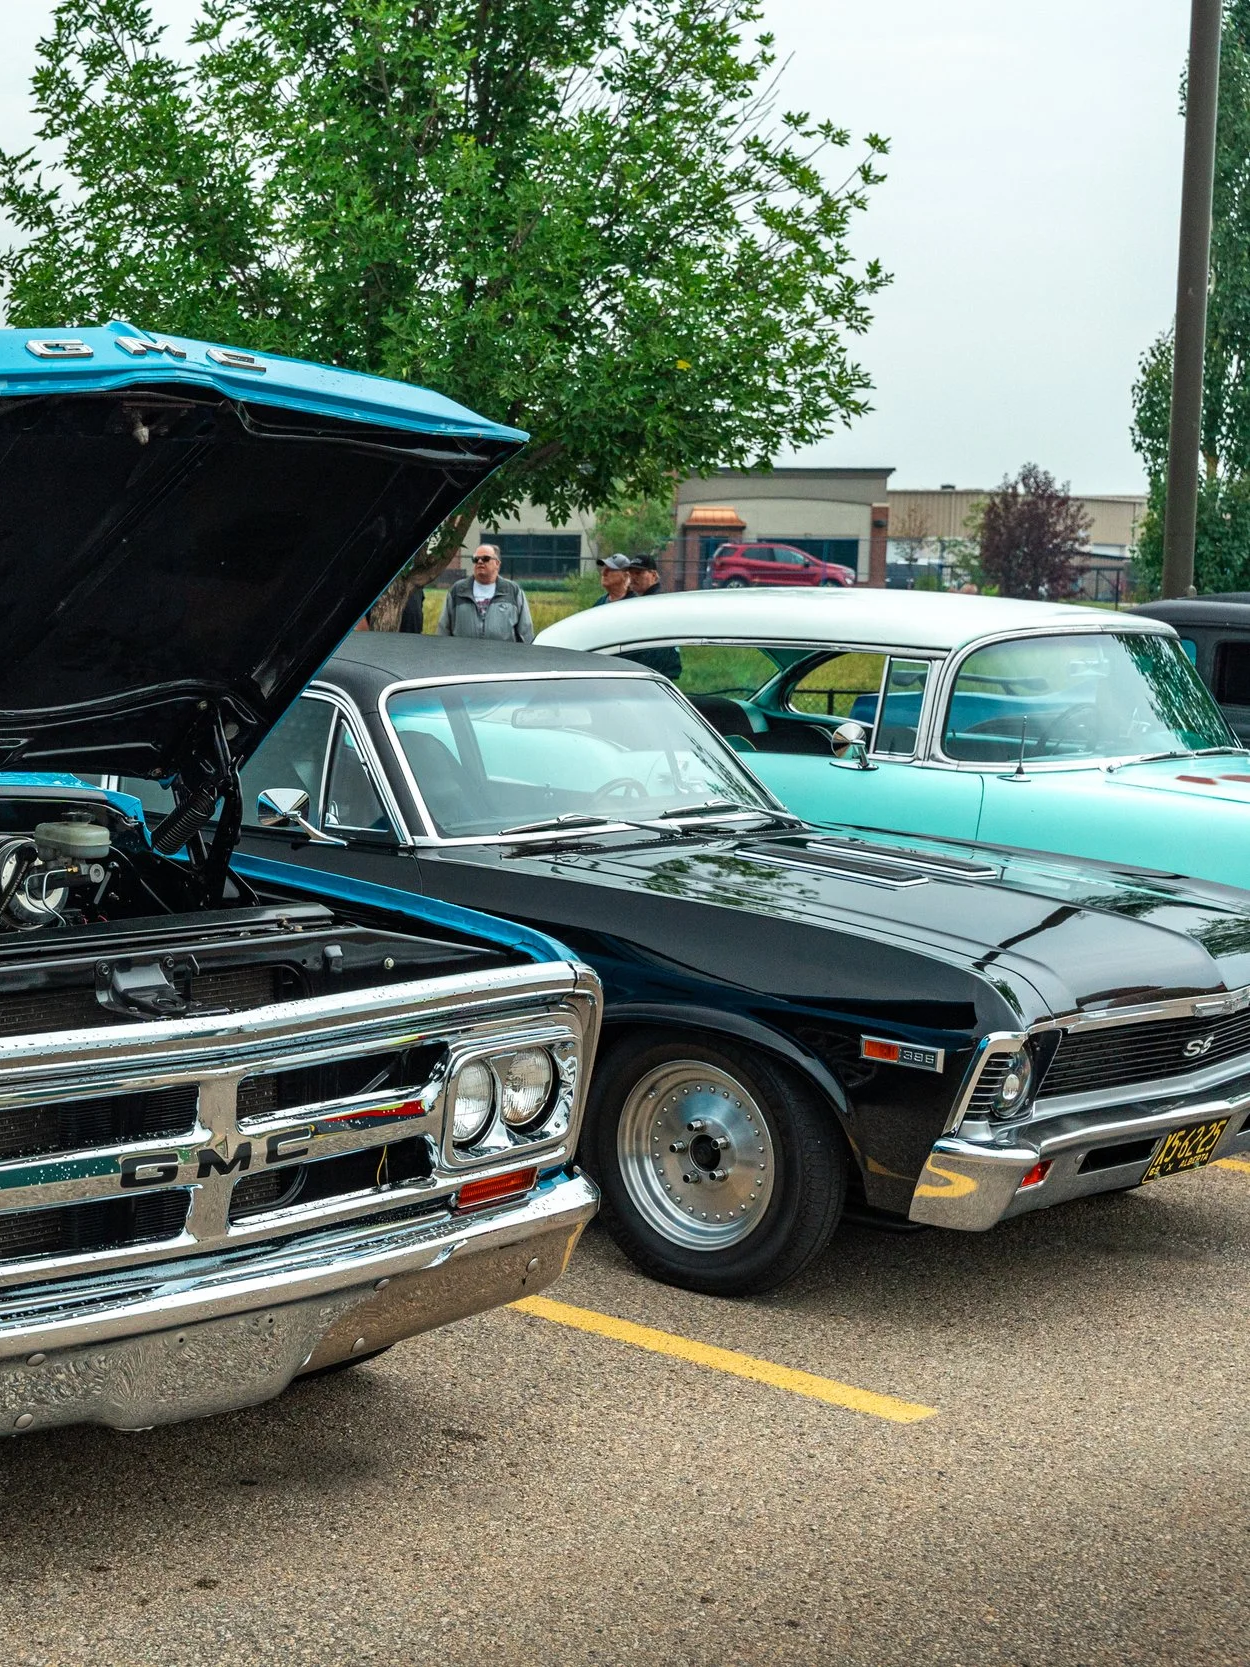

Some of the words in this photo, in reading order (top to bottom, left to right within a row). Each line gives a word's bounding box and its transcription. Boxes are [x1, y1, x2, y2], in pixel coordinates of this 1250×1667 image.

[25, 336, 267, 373] GMC
[903, 1050, 935, 1064] 396
[1183, 1036, 1215, 1057] SS
[120, 1125, 312, 1188] GMC
[1177, 1152, 1210, 1169] ALBERTA
